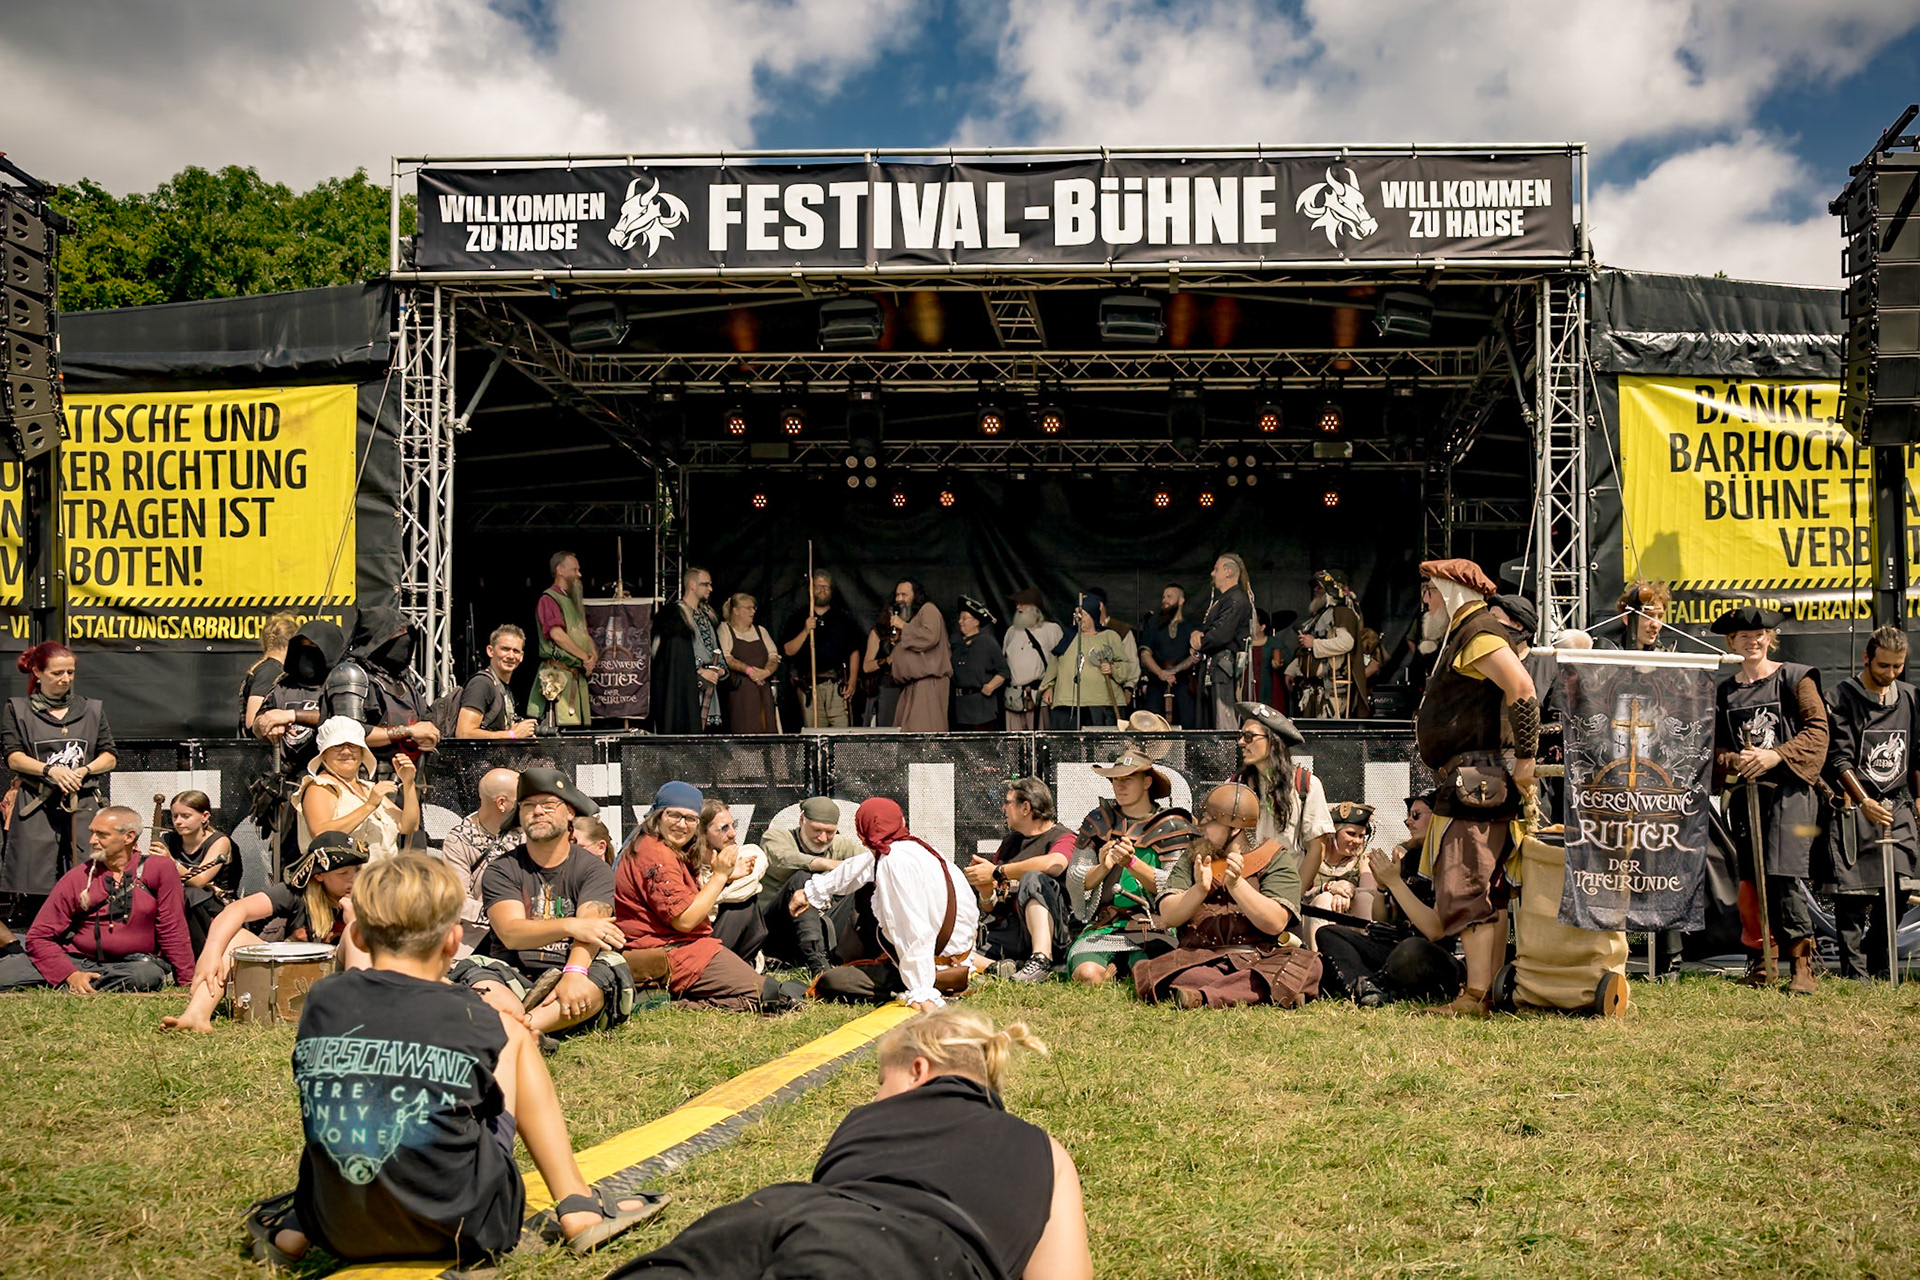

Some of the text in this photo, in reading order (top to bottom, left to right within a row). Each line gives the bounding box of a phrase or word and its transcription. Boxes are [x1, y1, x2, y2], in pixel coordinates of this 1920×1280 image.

[438, 192, 606, 223] WILLKOMMEN
[1380, 179, 1552, 208] WILLKOMMEN
[708, 176, 1277, 252] FESTIVAL-BÜHNE
[1408, 209, 1525, 238] ZU HAUSE
[465, 222, 578, 252] ZU HAUSE
[203, 402, 281, 443] UND
[1669, 429, 1871, 473] BARHOCKE
[123, 448, 307, 491] RICHTUNG
[1704, 473, 1830, 521] BÜHNE
[63, 497, 206, 539] TRAGEN
[218, 496, 276, 538] IST
[1564, 819, 1698, 852] RITTER
[1607, 858, 1646, 875] DER
[390, 1085, 457, 1106] CAN
[303, 1104, 369, 1121] ONLY
[326, 1127, 388, 1145] ONE
